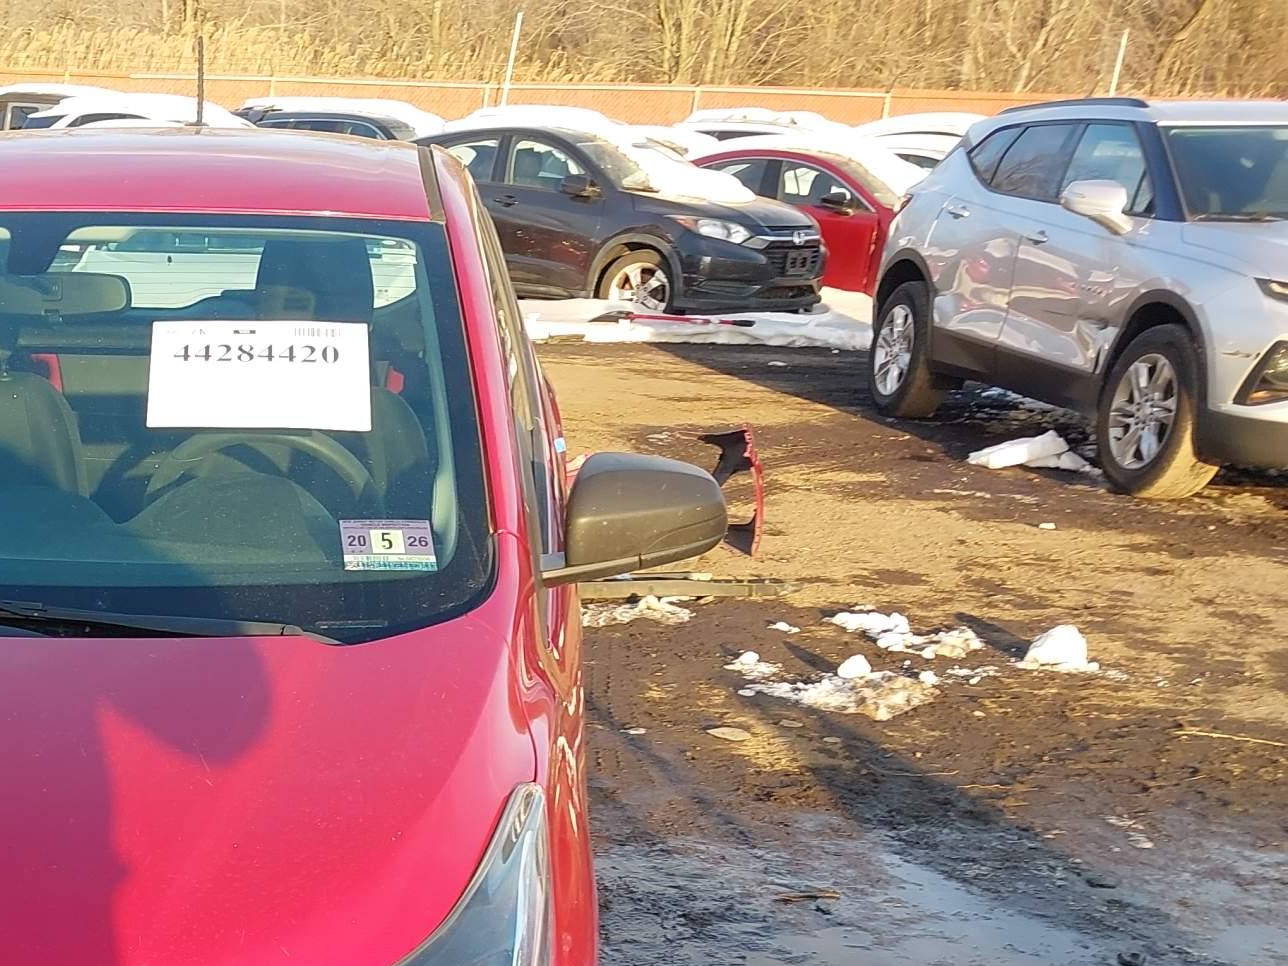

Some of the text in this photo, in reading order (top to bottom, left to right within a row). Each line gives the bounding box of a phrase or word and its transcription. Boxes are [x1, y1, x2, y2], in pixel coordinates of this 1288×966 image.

[173, 343, 340, 364] 44284420
[347, 532, 429, 550] 20 5 26
